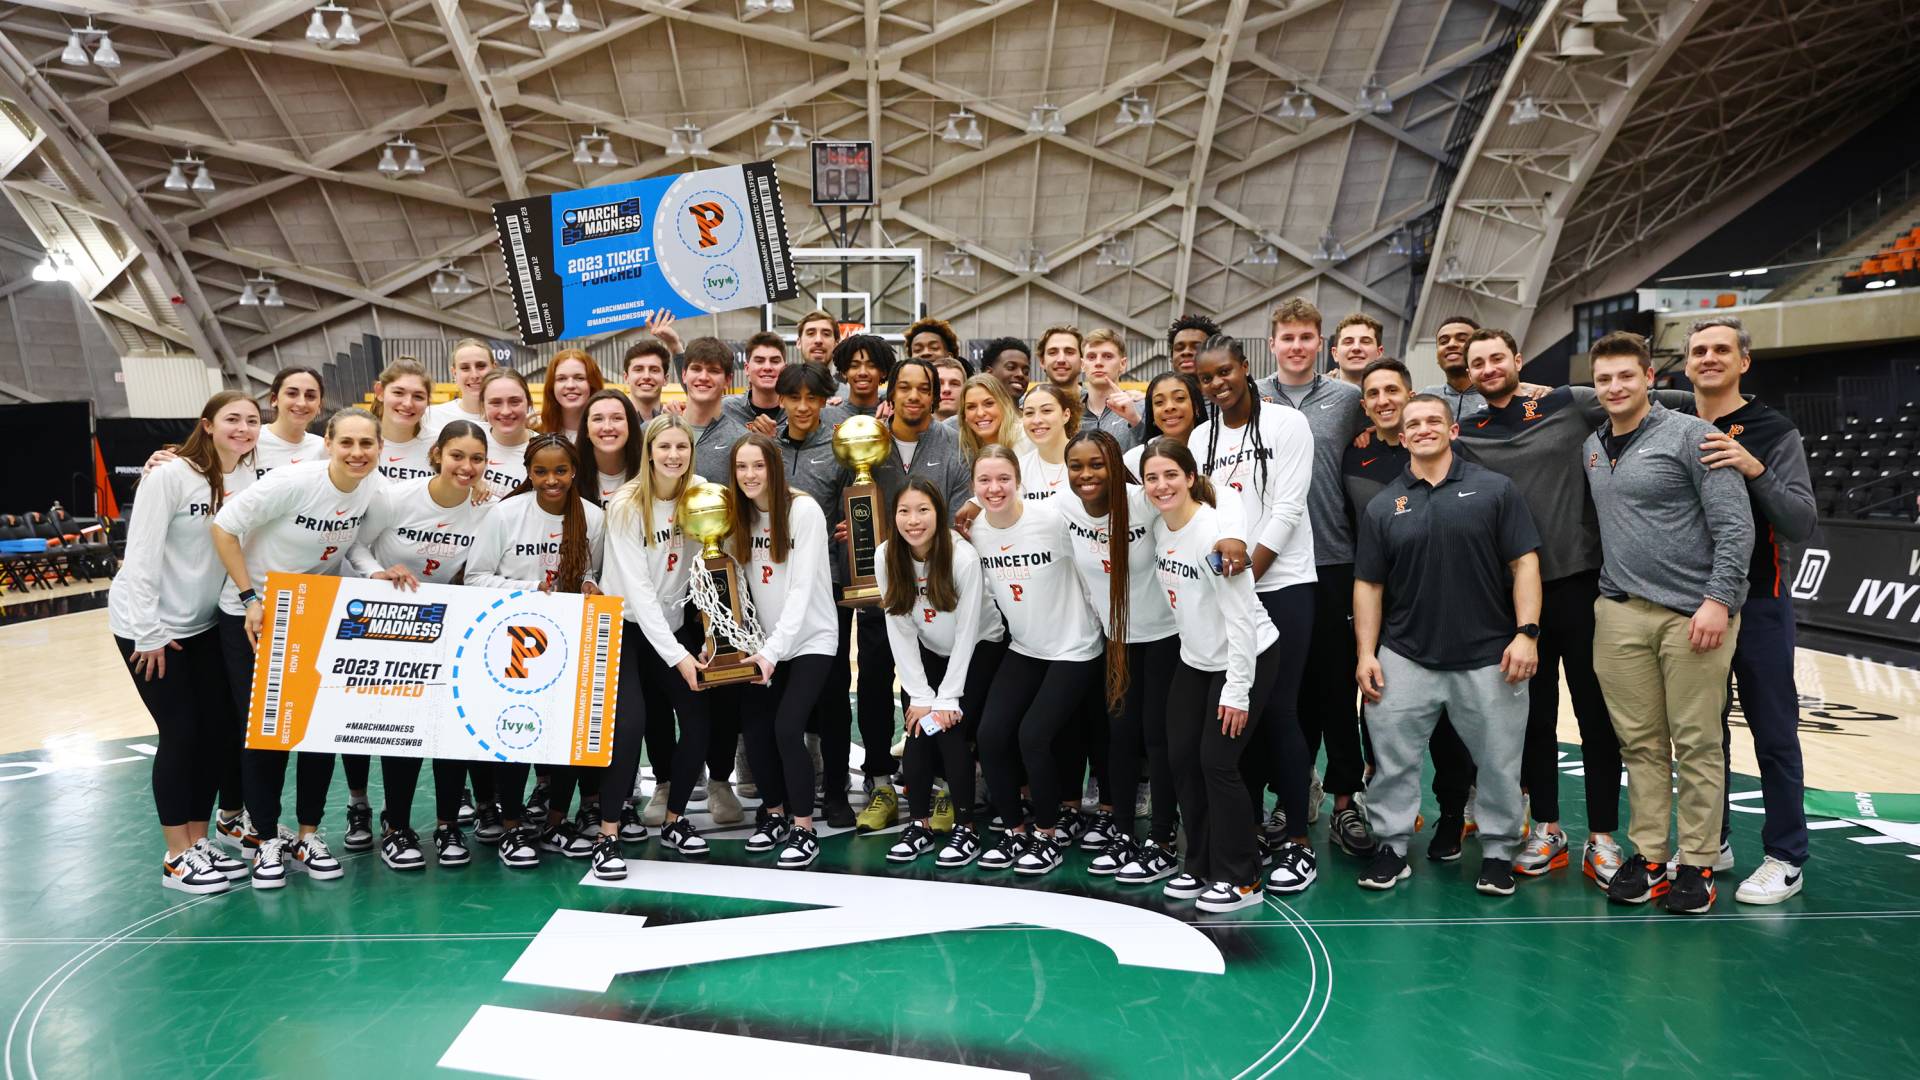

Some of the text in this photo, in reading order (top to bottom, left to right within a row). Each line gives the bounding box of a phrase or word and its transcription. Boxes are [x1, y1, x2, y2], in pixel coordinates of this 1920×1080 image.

[747, 170, 758, 204] QUALIFIER
[520, 206, 531, 233] SEAT 23
[577, 205, 618, 223] MARCH
[754, 204, 765, 240] AUTOMATIC
[584, 215, 641, 235] MADNESS
[689, 201, 724, 248] P
[531, 256, 542, 281] ROW 12
[568, 246, 650, 273] 2023 TICKET
[761, 241, 773, 282] TOURNAMENT
[581, 264, 642, 287] PUNCHED
[707, 277, 724, 288] Ivy
[592, 300, 644, 314] #MARCHMADNESS
[543, 308, 554, 337] SECTION
[492, 349, 511, 360] 109
[972, 349, 984, 360] 11
[320, 546, 338, 561] P
[516, 542, 561, 556] PRINC
[422, 559, 441, 576] P
[667, 553, 678, 572] P
[762, 566, 773, 584] P
[296, 583, 307, 615] SEAT 23
[1009, 584, 1024, 602] P
[1847, 578, 1920, 620] IVY
[363, 603, 419, 620] MARCH
[923, 608, 936, 623] P
[368, 619, 441, 638] MADNESS
[289, 644, 301, 673] ROW 12
[505, 626, 548, 679] P
[331, 657, 442, 680] 2023 TICKET
[344, 676, 425, 698] PUNCHED
[575, 603, 596, 760] NCAA TOURNAMENT AUTOMATIC QUALIFIER
[281, 708, 292, 744] SECTION
[345, 722, 415, 733] #MARCHMADNESS
[502, 719, 525, 734] Ivy
[334, 734, 423, 747] @MARCHMADNESSWBB
